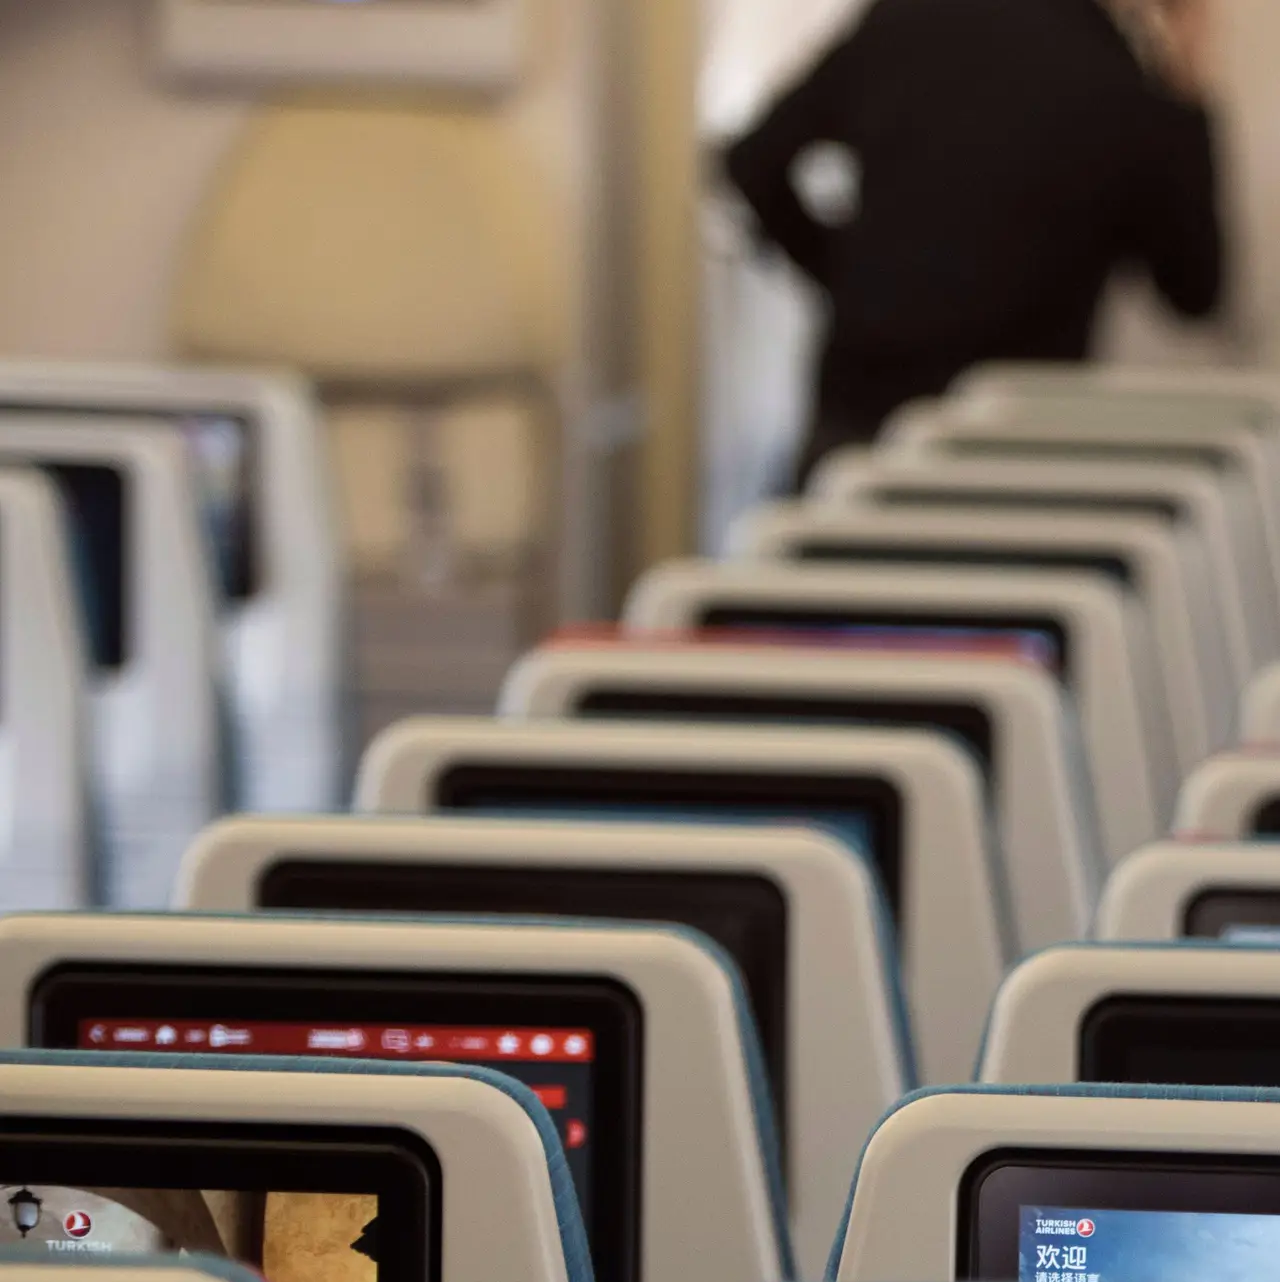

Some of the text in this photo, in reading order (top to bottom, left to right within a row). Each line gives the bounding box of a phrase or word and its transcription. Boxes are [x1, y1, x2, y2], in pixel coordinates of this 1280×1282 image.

[1035, 1219, 1076, 1227] TURKISH
[1035, 1227, 1076, 1235] AIRLINES
[1036, 1244, 1087, 1270] 欢迎
